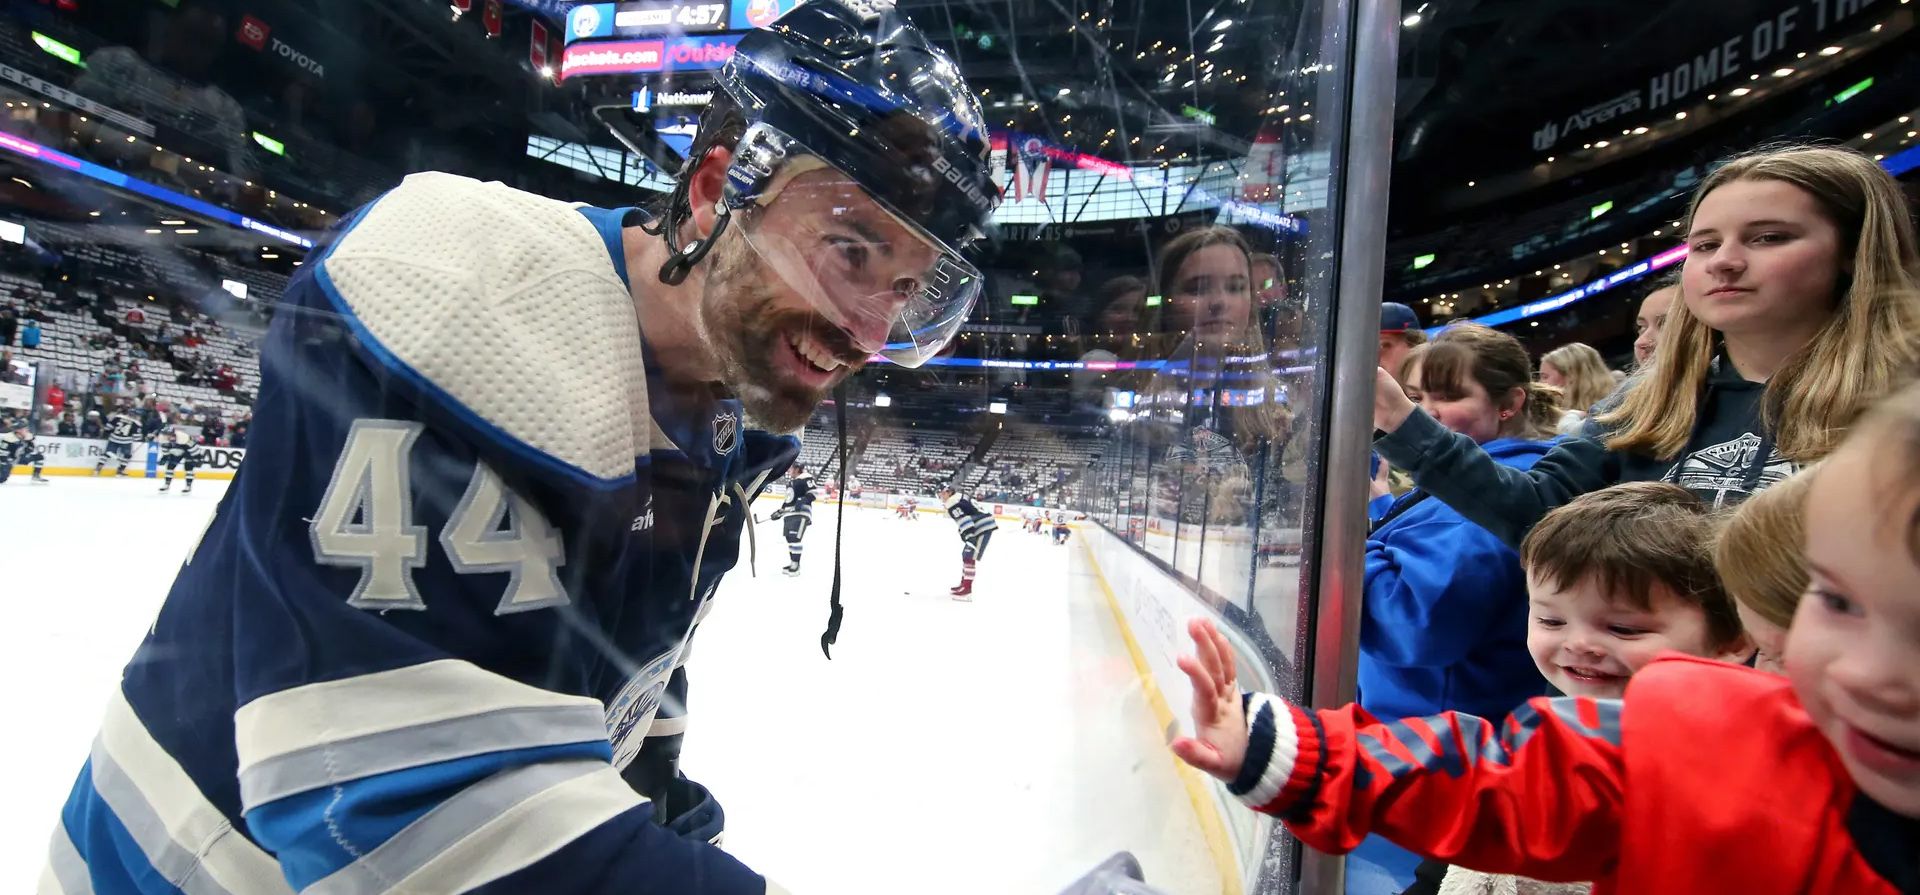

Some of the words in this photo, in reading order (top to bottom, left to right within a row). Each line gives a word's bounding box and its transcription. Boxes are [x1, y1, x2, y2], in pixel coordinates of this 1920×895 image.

[676, 4, 724, 25] 4:57
[271, 38, 325, 78] TOYOTA
[1649, 34, 1743, 110] HOME
[1751, 5, 1799, 62] OF
[1811, 0, 1872, 33] TH
[717, 421, 734, 447] NHL
[309, 418, 571, 616] 44
